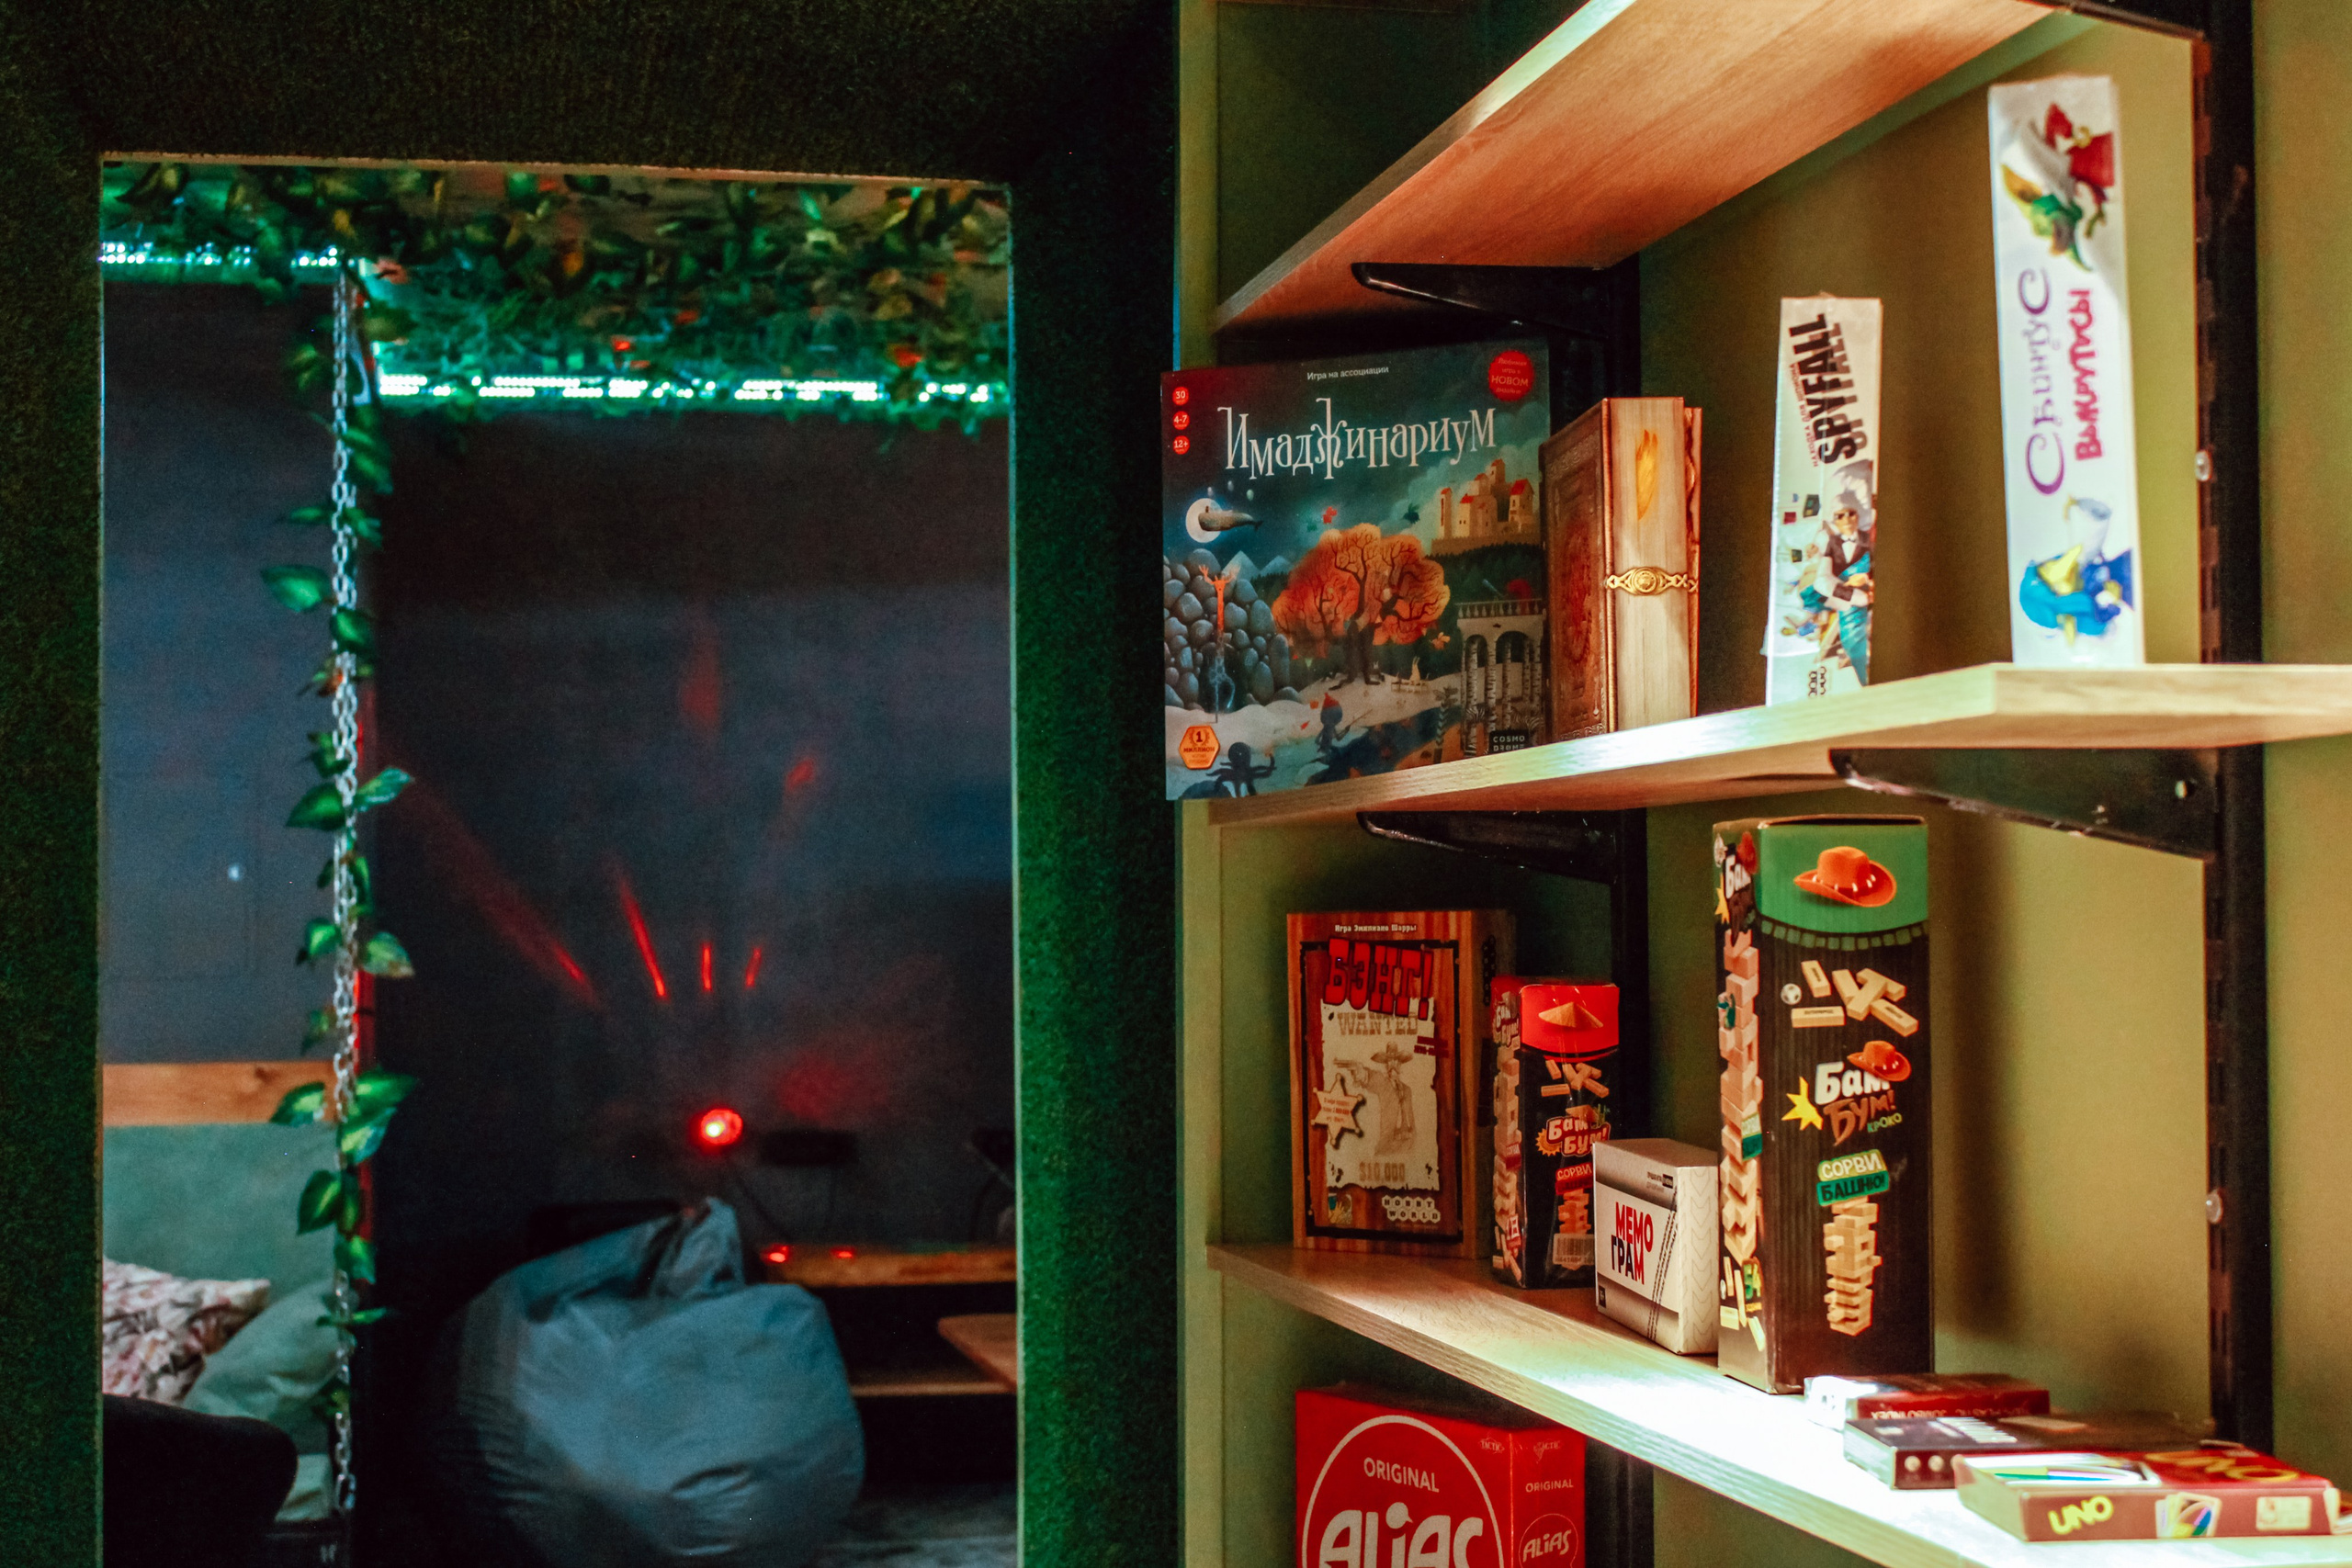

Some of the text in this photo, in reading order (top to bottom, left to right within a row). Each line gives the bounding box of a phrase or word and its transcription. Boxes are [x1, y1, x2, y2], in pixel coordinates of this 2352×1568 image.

[1306, 372, 1327, 381] Игра
[1340, 367, 1389, 378] ассоциации
[1491, 375, 1529, 387] НОВОМ
[1175, 390, 1186, 399] 30
[1788, 313, 1859, 465] SPYFALL
[1173, 414, 1188, 423] 4-7
[1174, 440, 1188, 448] 12+
[1217, 397, 1497, 479] Имаджинариум
[1196, 731, 1203, 742] 1
[1335, 924, 1351, 933] Игра
[1323, 937, 1433, 1021] БЭНГ!
[1337, 1012, 1419, 1035] WANTED
[1866, 1112, 1903, 1133] КРОКО
[1557, 1164, 1592, 1180] СОРВИ
[1821, 1152, 1883, 1179] СОРВИ
[1383, 1198, 1434, 1209] HOBBY
[1388, 1209, 1439, 1220] WORLD
[1615, 1201, 1654, 1253] МЕМО
[1611, 1235, 1645, 1285] ГРАМ
[1363, 1457, 1440, 1494] ORIGINAL
[1525, 1478, 1574, 1493] ORIGINAL
[2048, 1495, 2114, 1535] UNO
